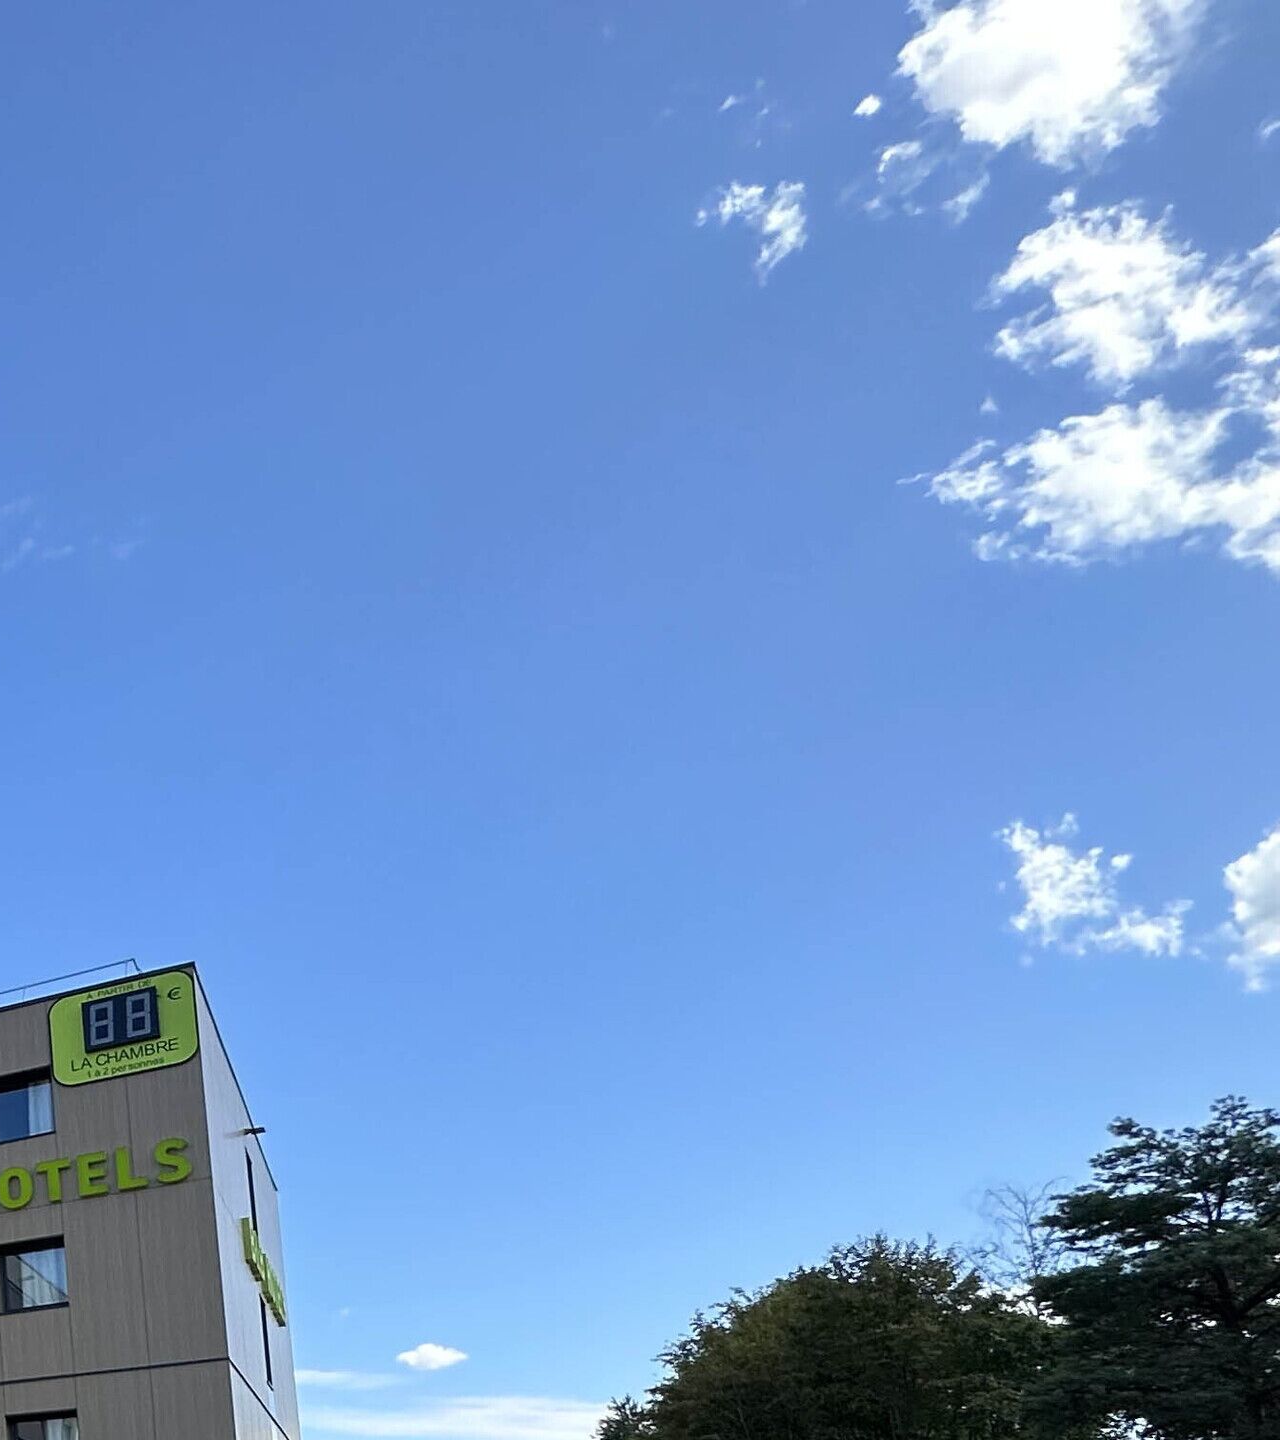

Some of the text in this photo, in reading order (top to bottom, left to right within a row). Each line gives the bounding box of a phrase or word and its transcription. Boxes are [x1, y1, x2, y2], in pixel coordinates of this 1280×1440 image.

[71, 1037, 179, 1072] LA CHAMBRE
[111, 1057, 165, 1076] personnes
